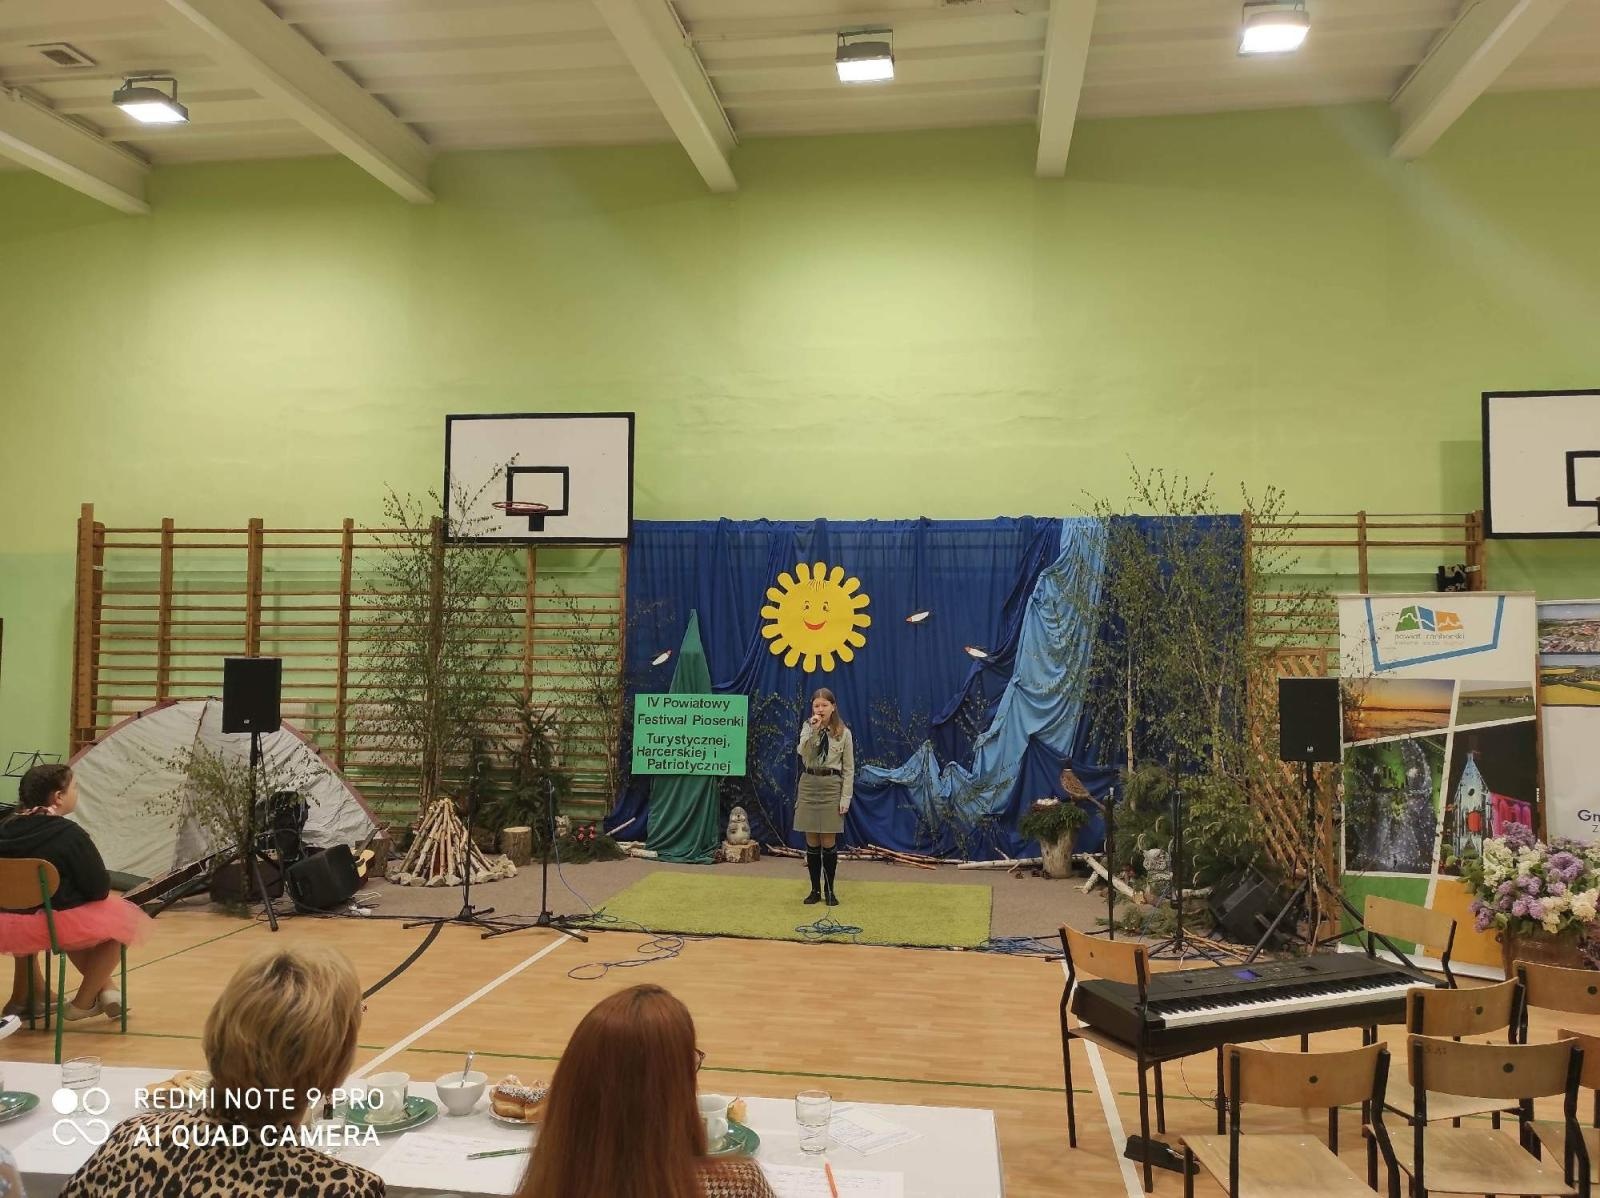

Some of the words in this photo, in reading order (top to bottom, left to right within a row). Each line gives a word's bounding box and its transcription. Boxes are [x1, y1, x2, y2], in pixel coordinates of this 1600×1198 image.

[647, 697, 660, 708] IV
[663, 697, 731, 712] Powiatowy
[638, 713, 687, 725] Festiwal
[692, 714, 744, 727] Piosenki
[646, 733, 730, 748] Turystycznej,
[636, 746, 707, 760] Harcerskiej
[713, 748, 717, 758] i
[647, 758, 731, 774] Patriotycznej
